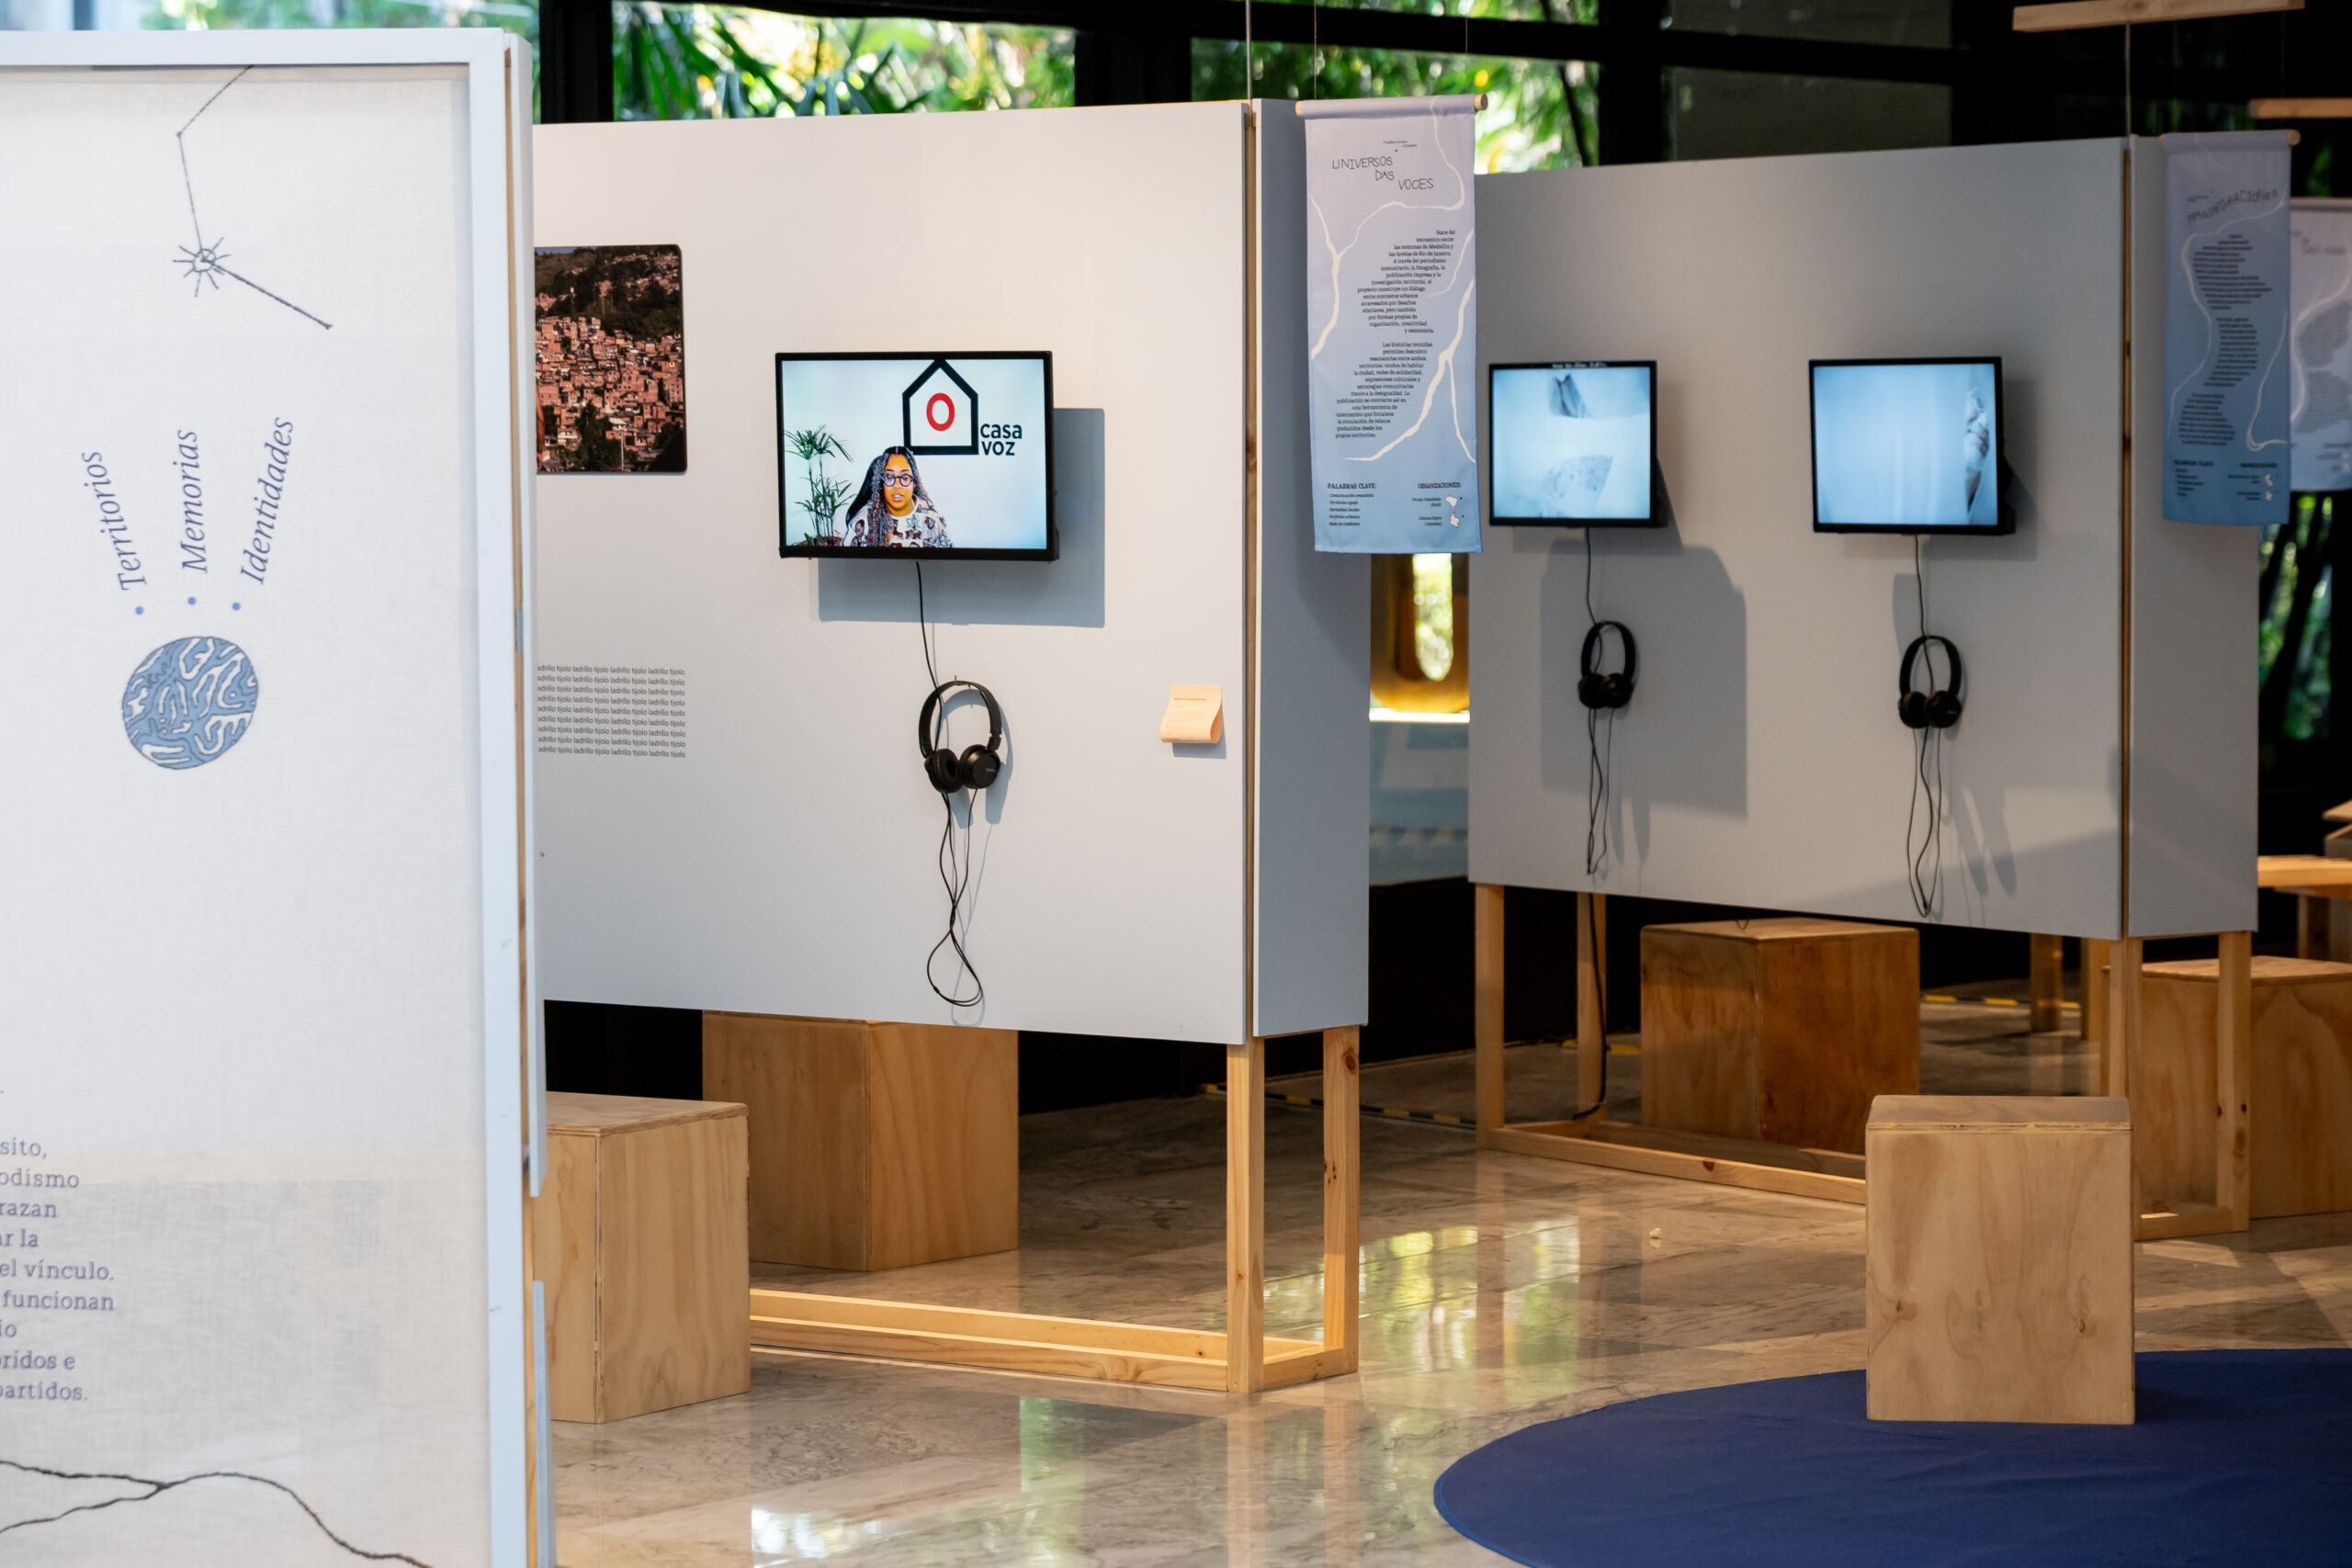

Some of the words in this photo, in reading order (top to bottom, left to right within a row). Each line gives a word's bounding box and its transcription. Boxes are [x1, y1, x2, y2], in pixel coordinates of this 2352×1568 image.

[1332, 156, 1393, 170] UNIVERSOS
[1375, 170, 1395, 180] DAS
[1398, 178, 1433, 190] VOCES
[980, 423, 1023, 439] casa
[981, 441, 1015, 456] voz
[172, 429, 209, 574] Memorias
[240, 416, 294, 585] Identidades
[81, 451, 147, 591] Territorios
[557, 685, 571, 694] tijolo
[557, 695, 571, 704] tijolo
[633, 728, 648, 737] tijolo
[0, 1137, 47, 1159] sito,
[0, 1168, 80, 1189] odismo
[20, 1228, 39, 1247] la
[25, 1258, 114, 1280] vínculo.
[3, 1290, 114, 1311] funcionan
[0, 1350, 57, 1370] ridos
[64, 1355, 75, 1370] e
